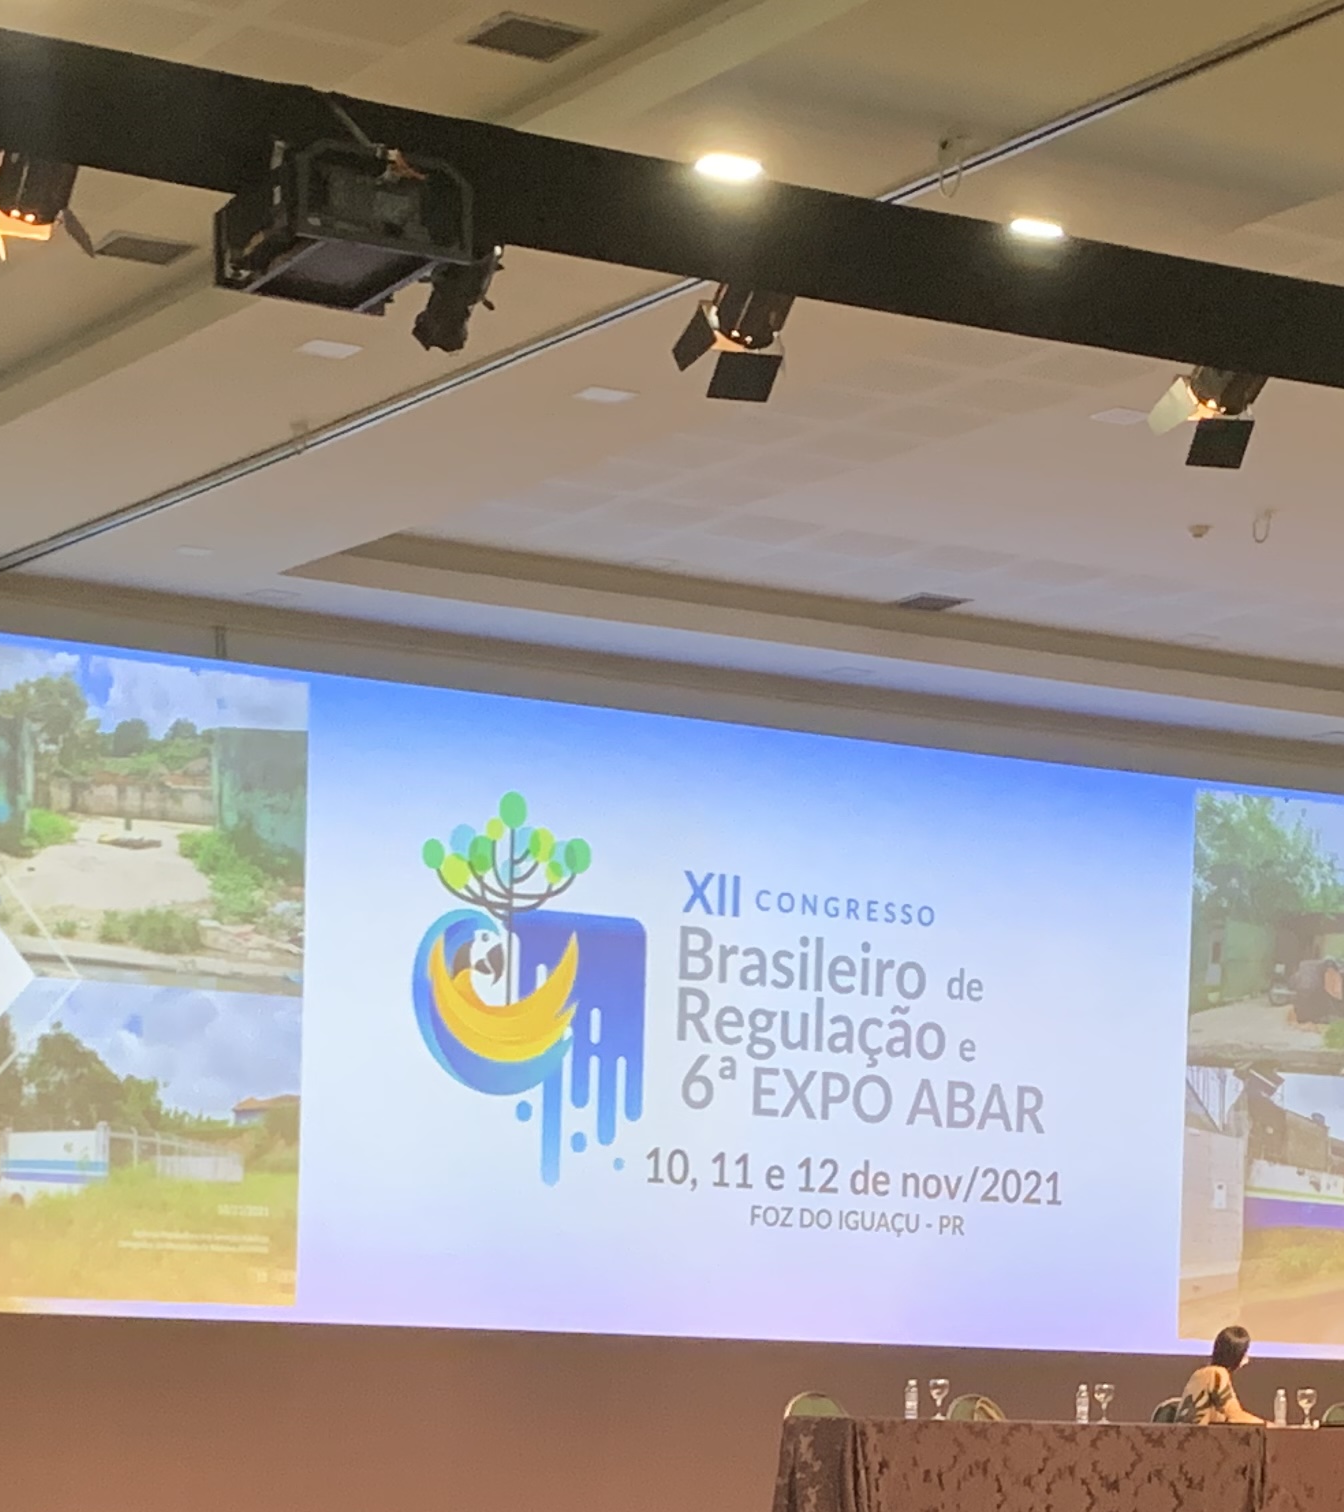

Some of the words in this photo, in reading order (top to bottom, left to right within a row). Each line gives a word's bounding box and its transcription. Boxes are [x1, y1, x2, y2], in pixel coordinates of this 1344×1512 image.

[682, 870, 740, 917] XII
[756, 889, 935, 927] CONGRESSO
[678, 925, 927, 1001] Brasileiro
[946, 967, 983, 1001] de
[676, 986, 946, 1068] Regulação
[959, 1038, 976, 1062] e
[752, 1066, 892, 1124] EXPO
[905, 1078, 1045, 1134] ABAR
[645, 1146, 698, 1192] 10,
[711, 1151, 753, 1189] 11
[764, 1163, 785, 1191] e
[797, 1156, 839, 1194] 12
[849, 1160, 890, 1197] de
[901, 1165, 1063, 1206] nov/2021
[749, 1205, 794, 1227] FOZ
[799, 1208, 833, 1230] DO
[838, 1210, 920, 1238] IGUAÇU
[938, 1215, 965, 1236] PR
